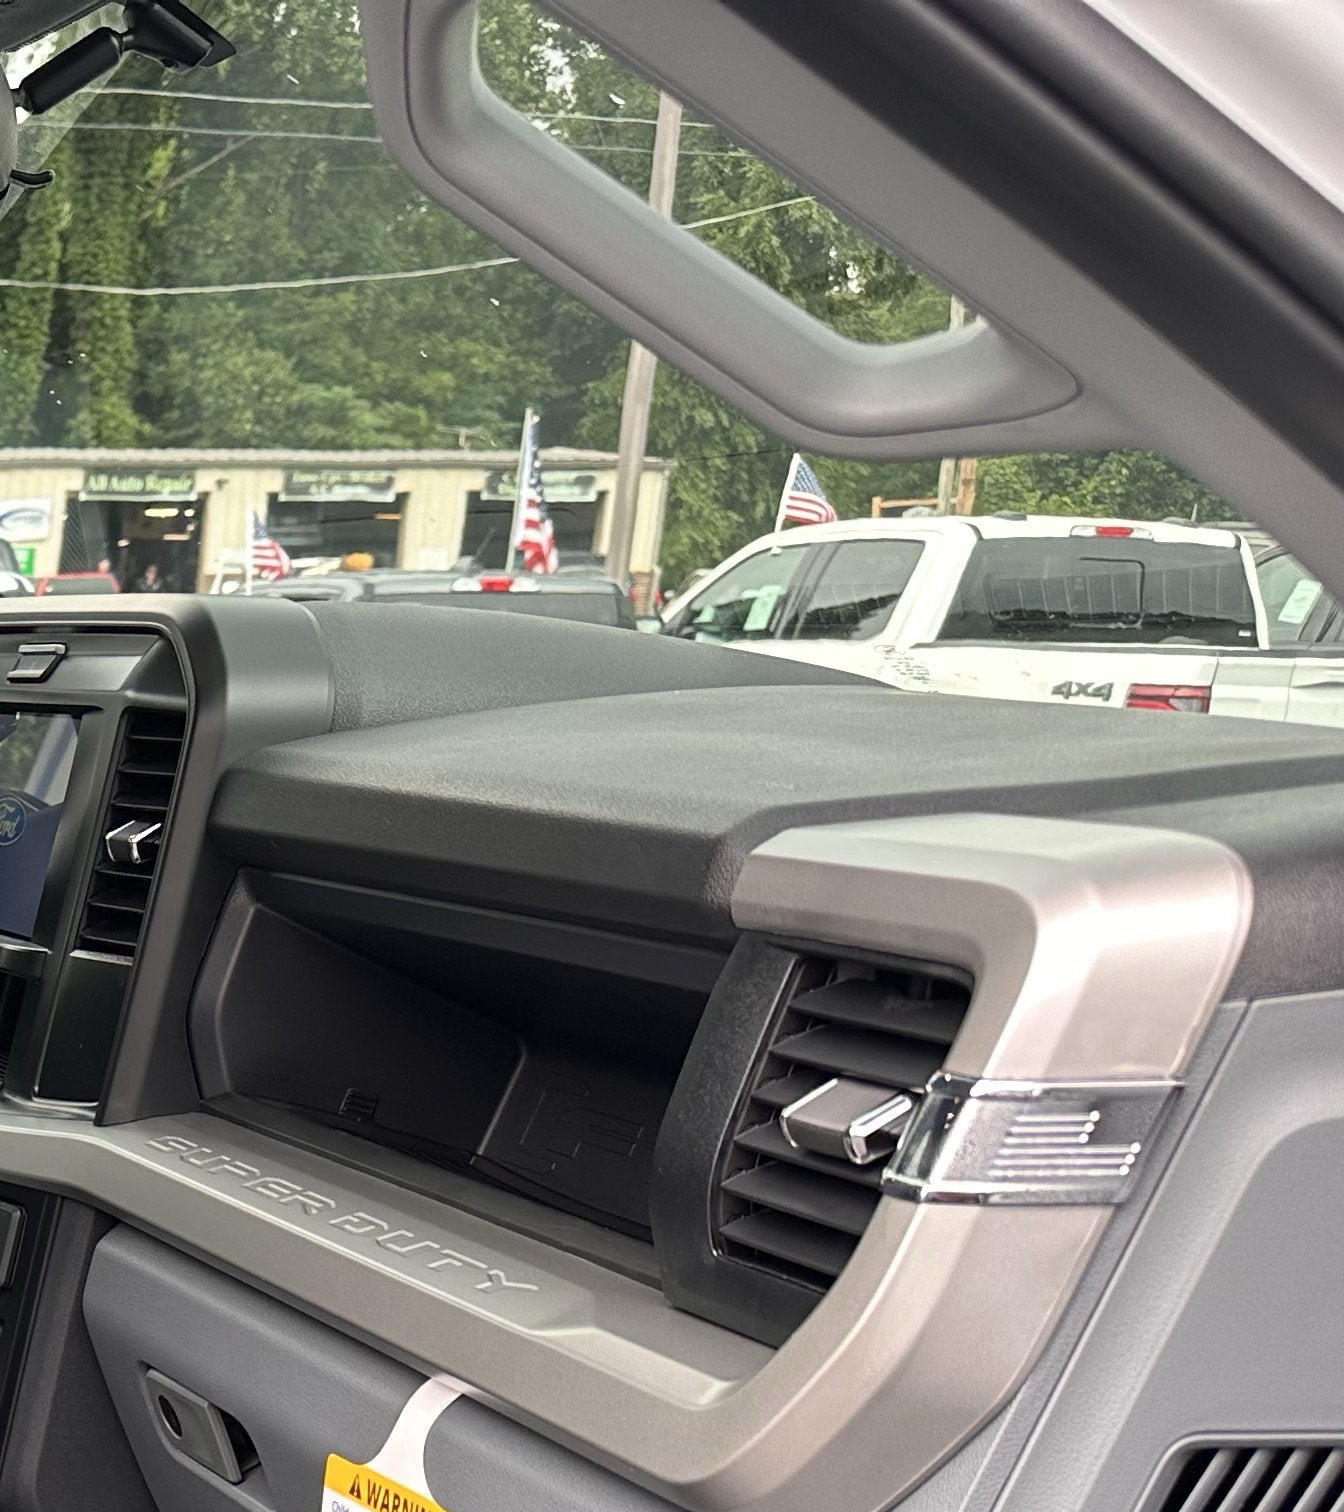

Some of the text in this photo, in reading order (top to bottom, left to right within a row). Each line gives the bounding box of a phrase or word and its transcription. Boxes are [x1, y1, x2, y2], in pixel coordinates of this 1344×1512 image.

[110, 475, 144, 491] Auto
[145, 1135, 539, 1295] SUPER DUTY
